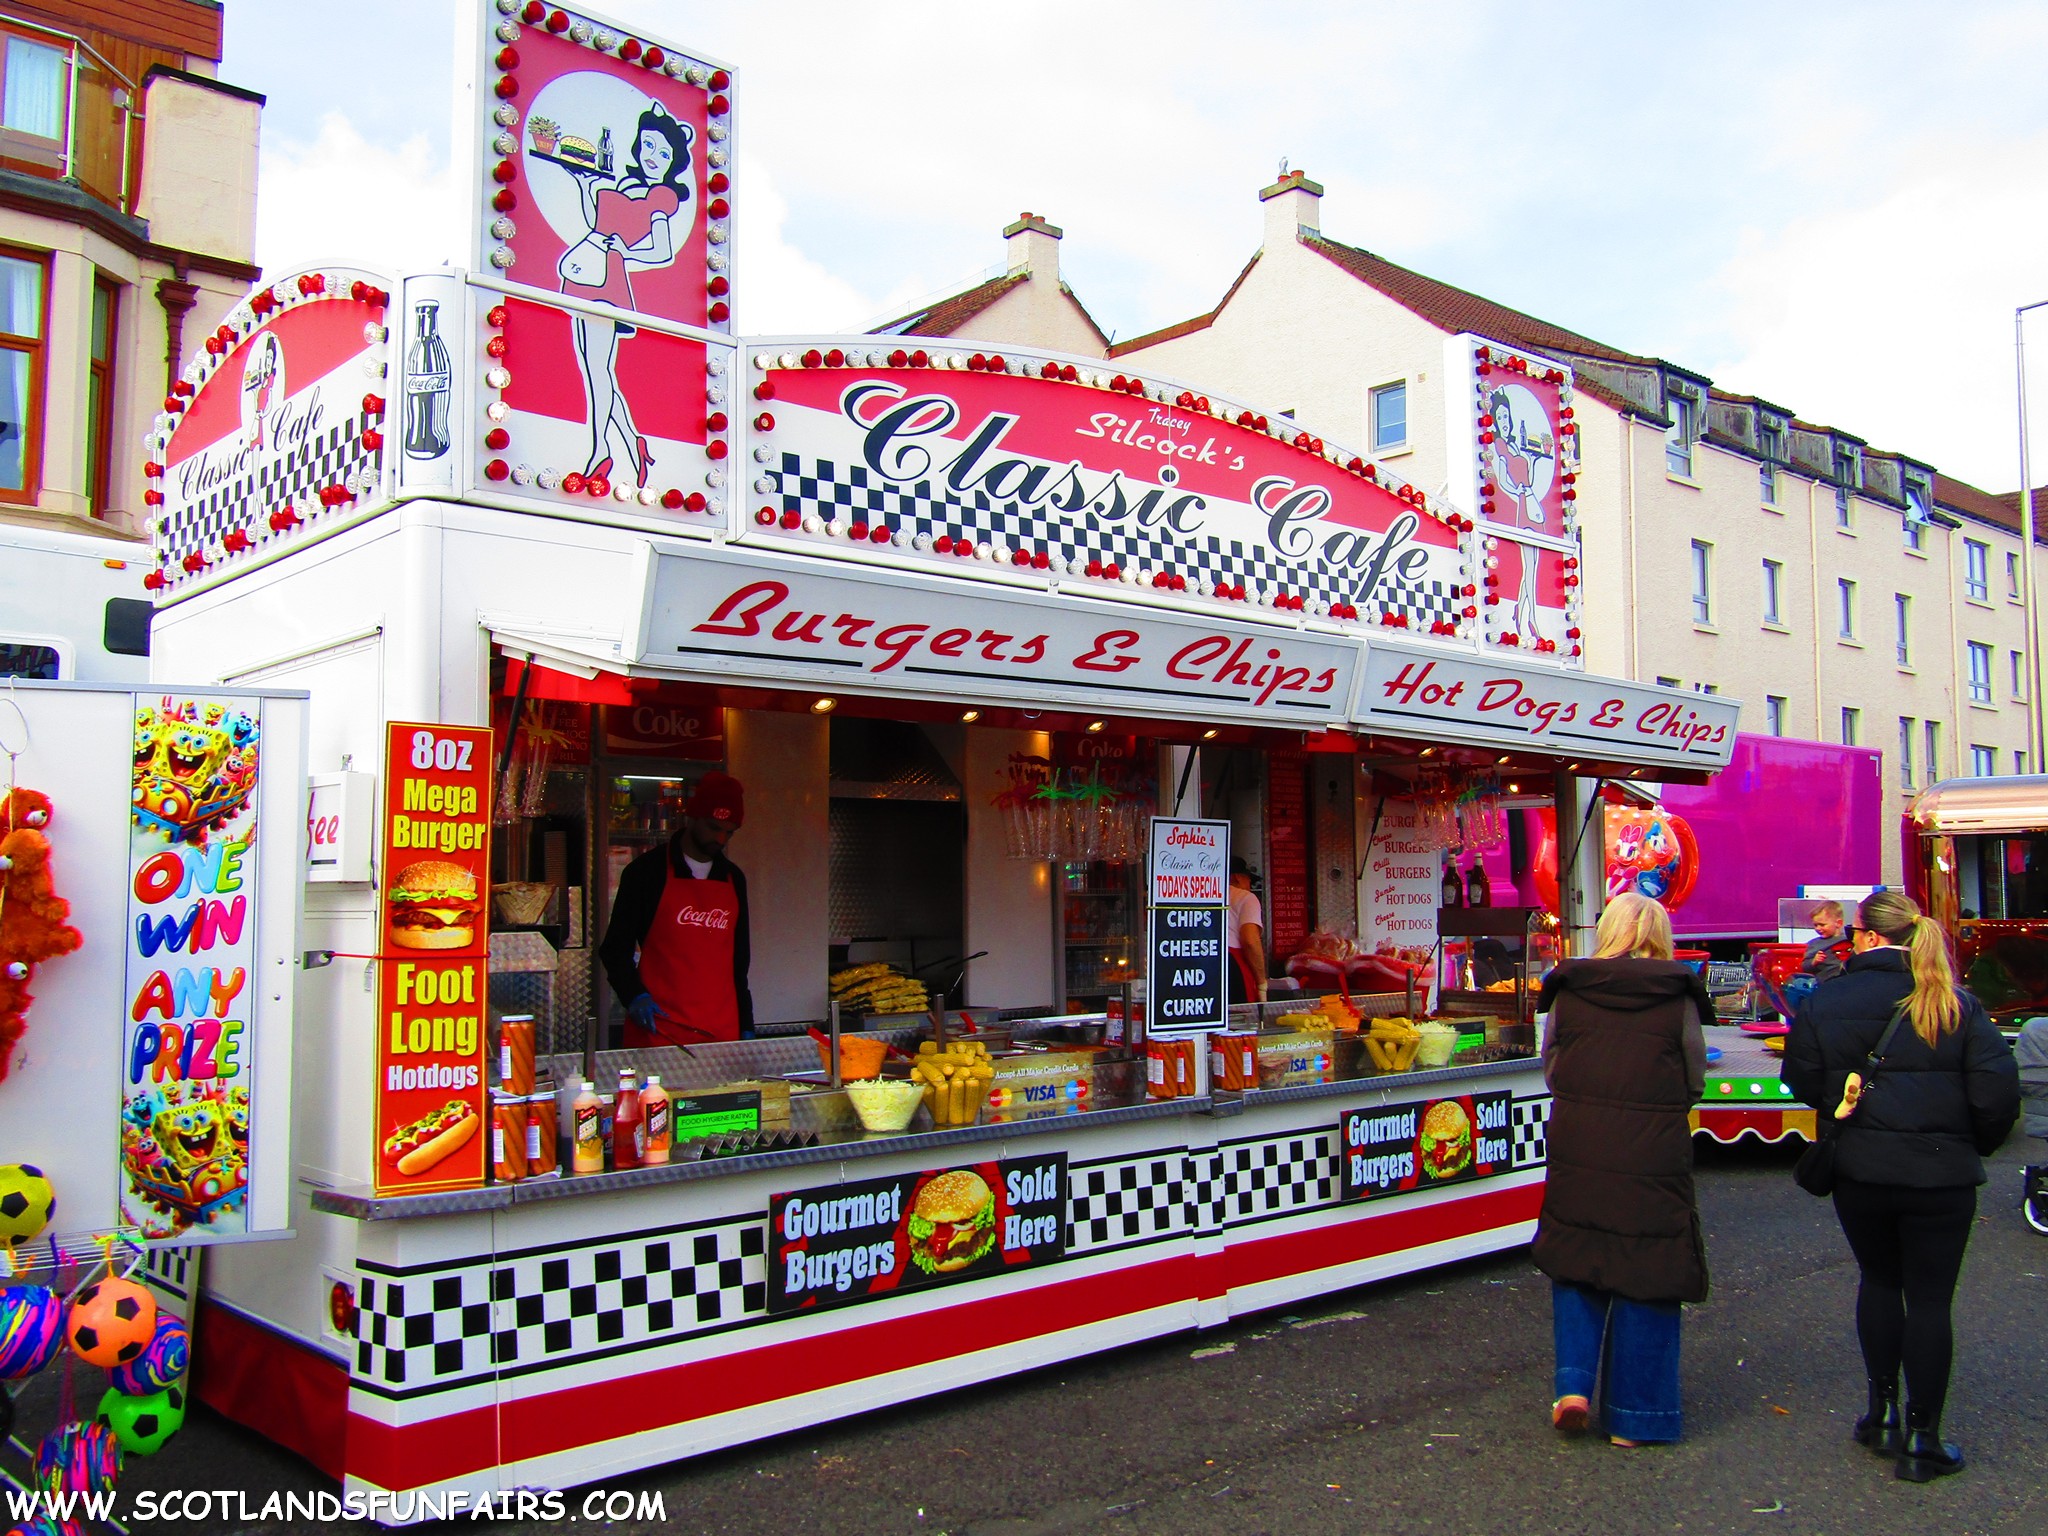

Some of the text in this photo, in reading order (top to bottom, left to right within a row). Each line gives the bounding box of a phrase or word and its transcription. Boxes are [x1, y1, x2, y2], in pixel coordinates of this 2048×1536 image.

[1148, 406, 1192, 437] Tracey
[179, 386, 324, 501] Classic Cafe
[1075, 412, 1246, 471] Silcock's
[843, 384, 1429, 603] Classic Cafe
[690, 580, 1338, 706] Burgers & Chips
[1383, 661, 1726, 752] Hot Dogs & Chips
[632, 706, 701, 738] Coke
[403, 778, 477, 817] Mega
[392, 814, 487, 853] Burger
[1166, 826, 1216, 849] Sophie's
[1372, 833, 1393, 847] Cheese
[134, 842, 247, 904] ONE
[1159, 851, 1222, 877] Classic Cafe
[1373, 858, 1391, 872] Chilli
[1385, 867, 1431, 879] BURGERS
[1156, 875, 1222, 899] TODAYS SPECIAL
[1374, 885, 1396, 903] Jumbo
[1386, 893, 1432, 905] HOT DOGS
[136, 895, 247, 958] WIN
[677, 905, 729, 930] Coca-Cola
[1167, 910, 1212, 928] CHIPS
[1375, 911, 1395, 926] Cheese
[1387, 919, 1433, 931] HOT DOGS
[1159, 939, 1218, 958] CHEESE
[396, 963, 476, 1006] Foot
[1172, 969, 1206, 987] AND
[132, 967, 246, 1022] ANY
[1163, 997, 1215, 1017] CURRY
[390, 1012, 478, 1056] Long
[130, 1018, 244, 1084] PRIZE
[1290, 1058, 1307, 1072] ISA
[388, 1063, 479, 1091] Hotdogs
[995, 1063, 1080, 1080] Accept All Major Credit Cards
[1023, 1084, 1056, 1102] VISA
[681, 1112, 754, 1126] FOOD HYGIENE RATING
[1349, 1099, 1507, 1147] Gourmet Sold
[1350, 1137, 1508, 1188] Burgers Here
[783, 1163, 1057, 1241] Gourmet Sold
[784, 1213, 1057, 1294] Burgers Here
